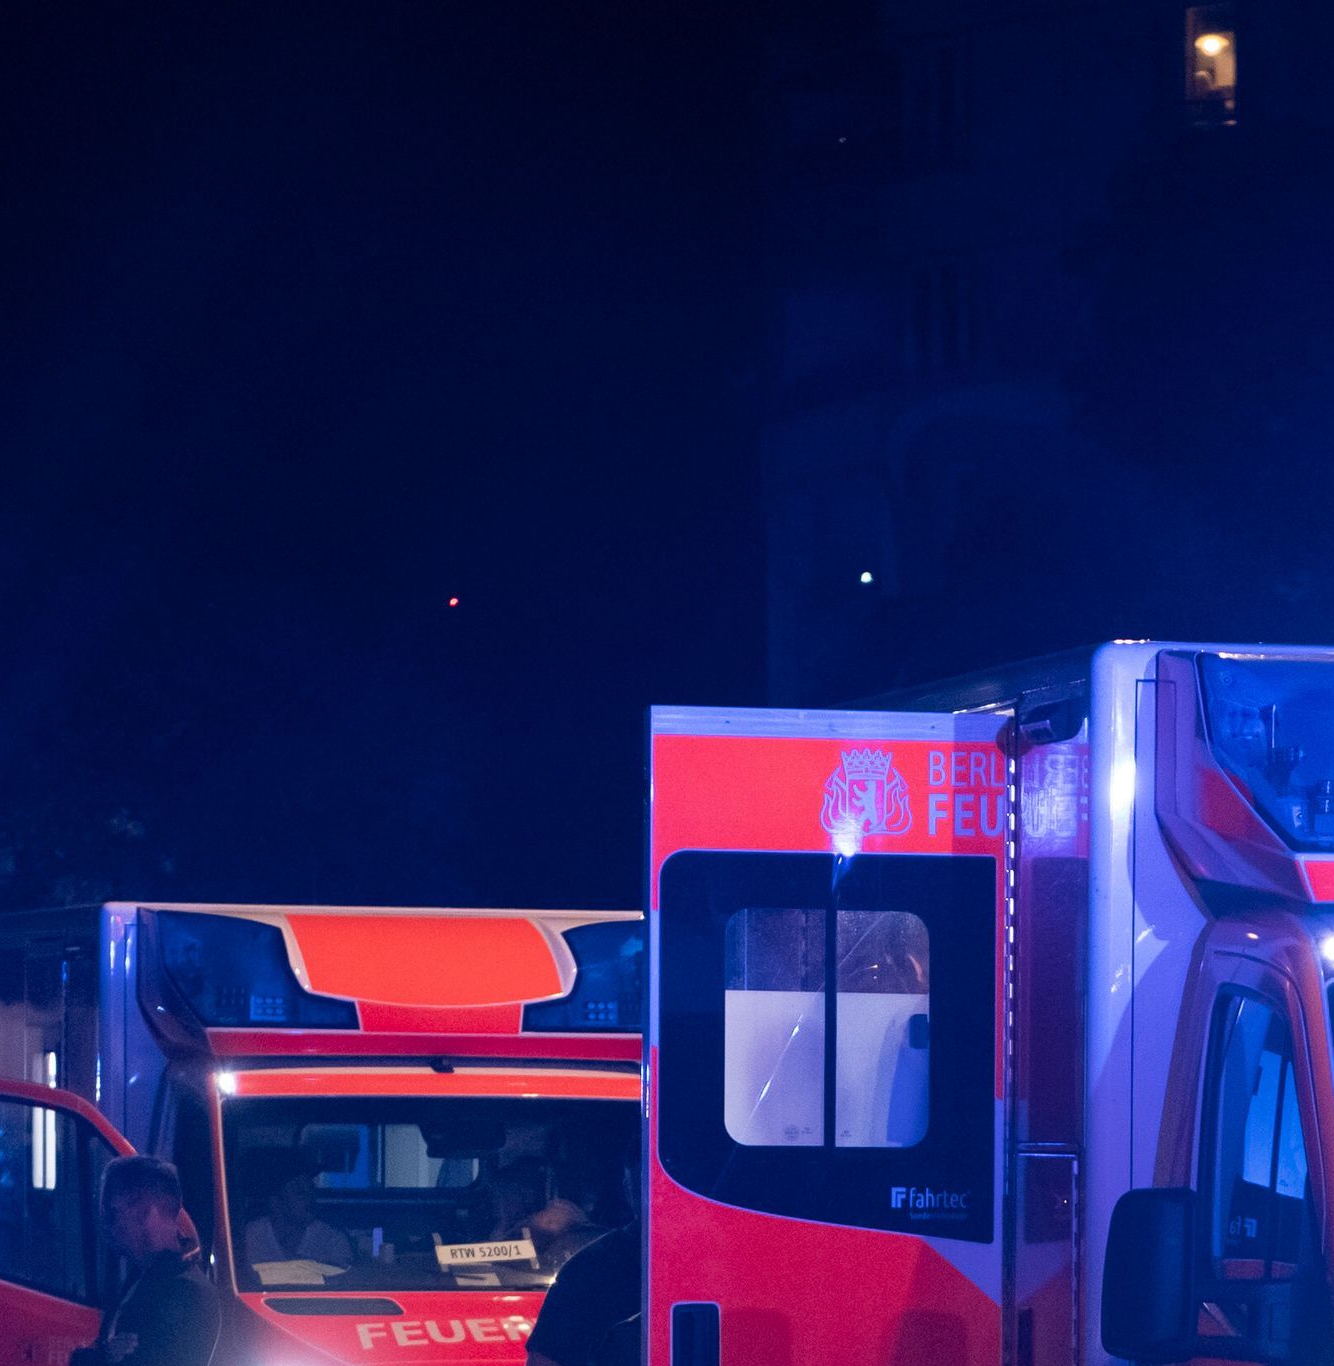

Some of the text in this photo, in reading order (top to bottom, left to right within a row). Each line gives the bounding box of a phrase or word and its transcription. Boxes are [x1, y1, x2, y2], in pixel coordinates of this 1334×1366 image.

[929, 751, 1004, 787] BERL
[928, 793, 1004, 837] FEU
[909, 1187, 967, 1209] fahrtec
[450, 1244, 521, 1259] RTW 5200/1
